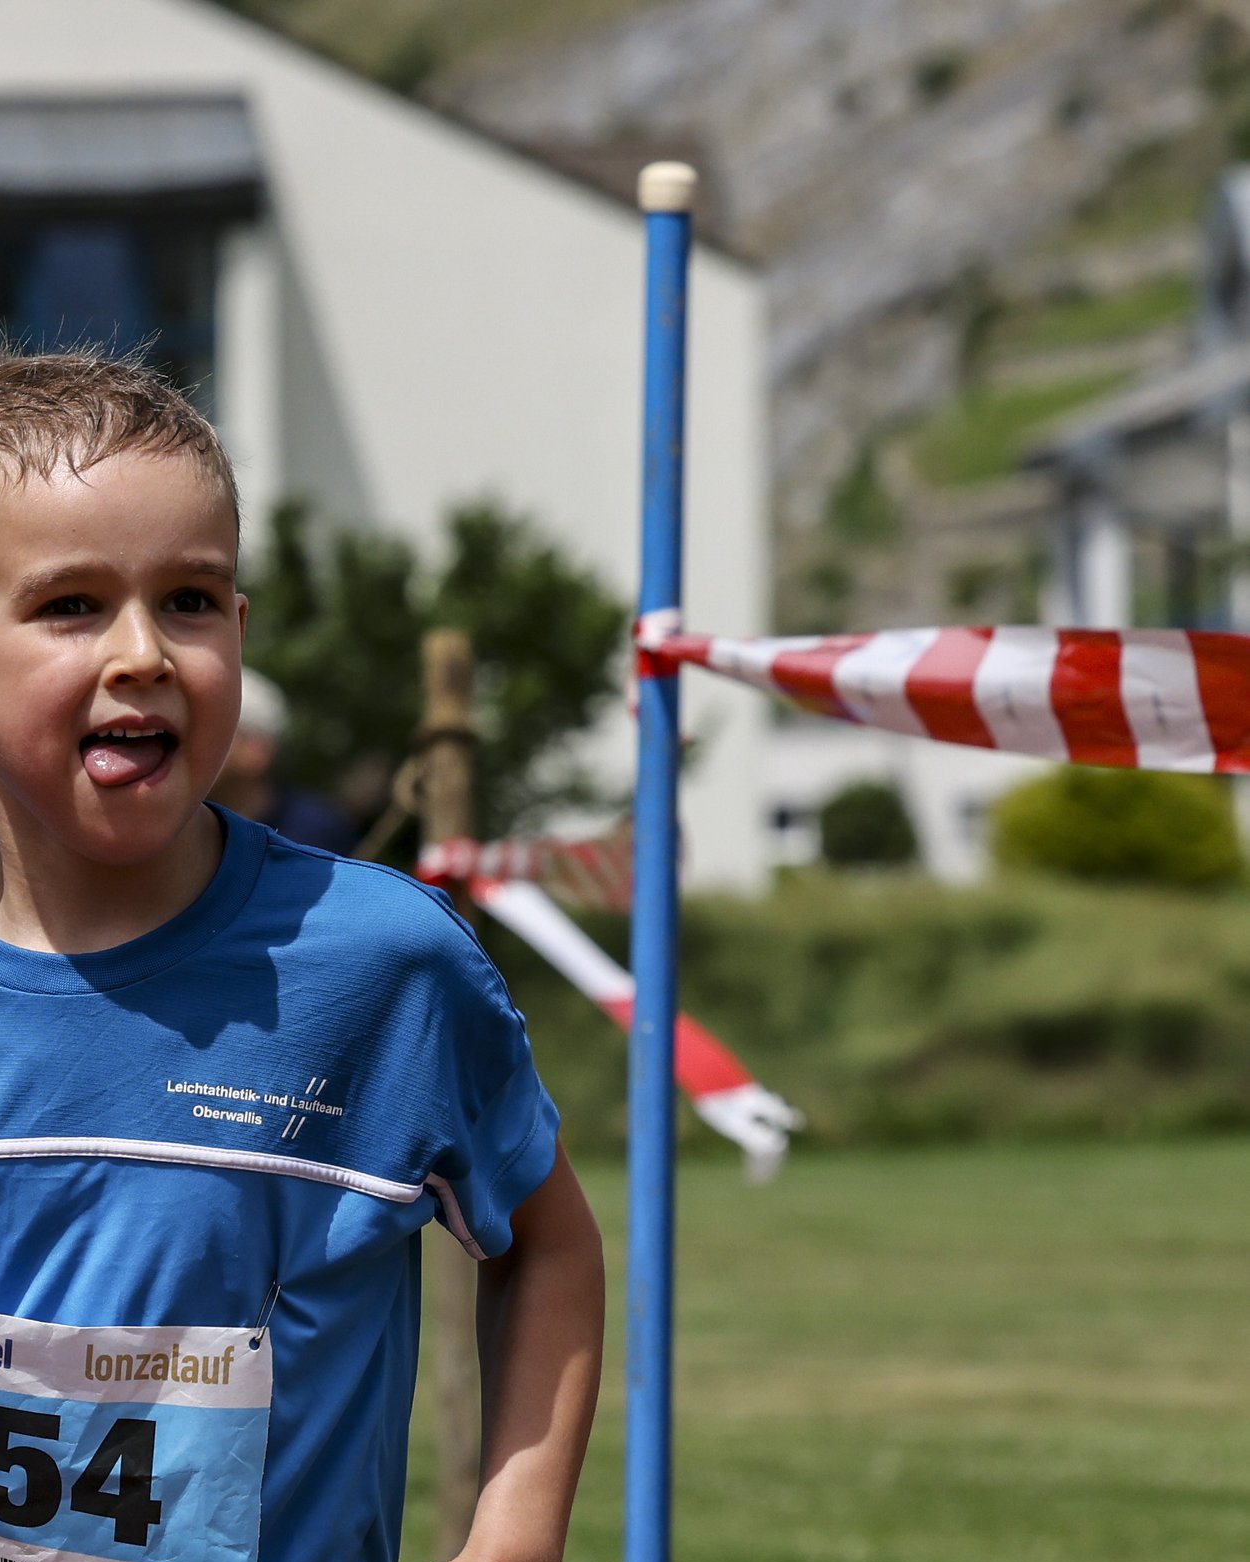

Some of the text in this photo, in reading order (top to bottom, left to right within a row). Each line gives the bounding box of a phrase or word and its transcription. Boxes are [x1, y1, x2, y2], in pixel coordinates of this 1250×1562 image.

[166, 1080, 343, 1117] Leichtathletik- und Laufteam
[192, 1105, 263, 1125] Oberwallis
[85, 1343, 235, 1385] lonzalauf
